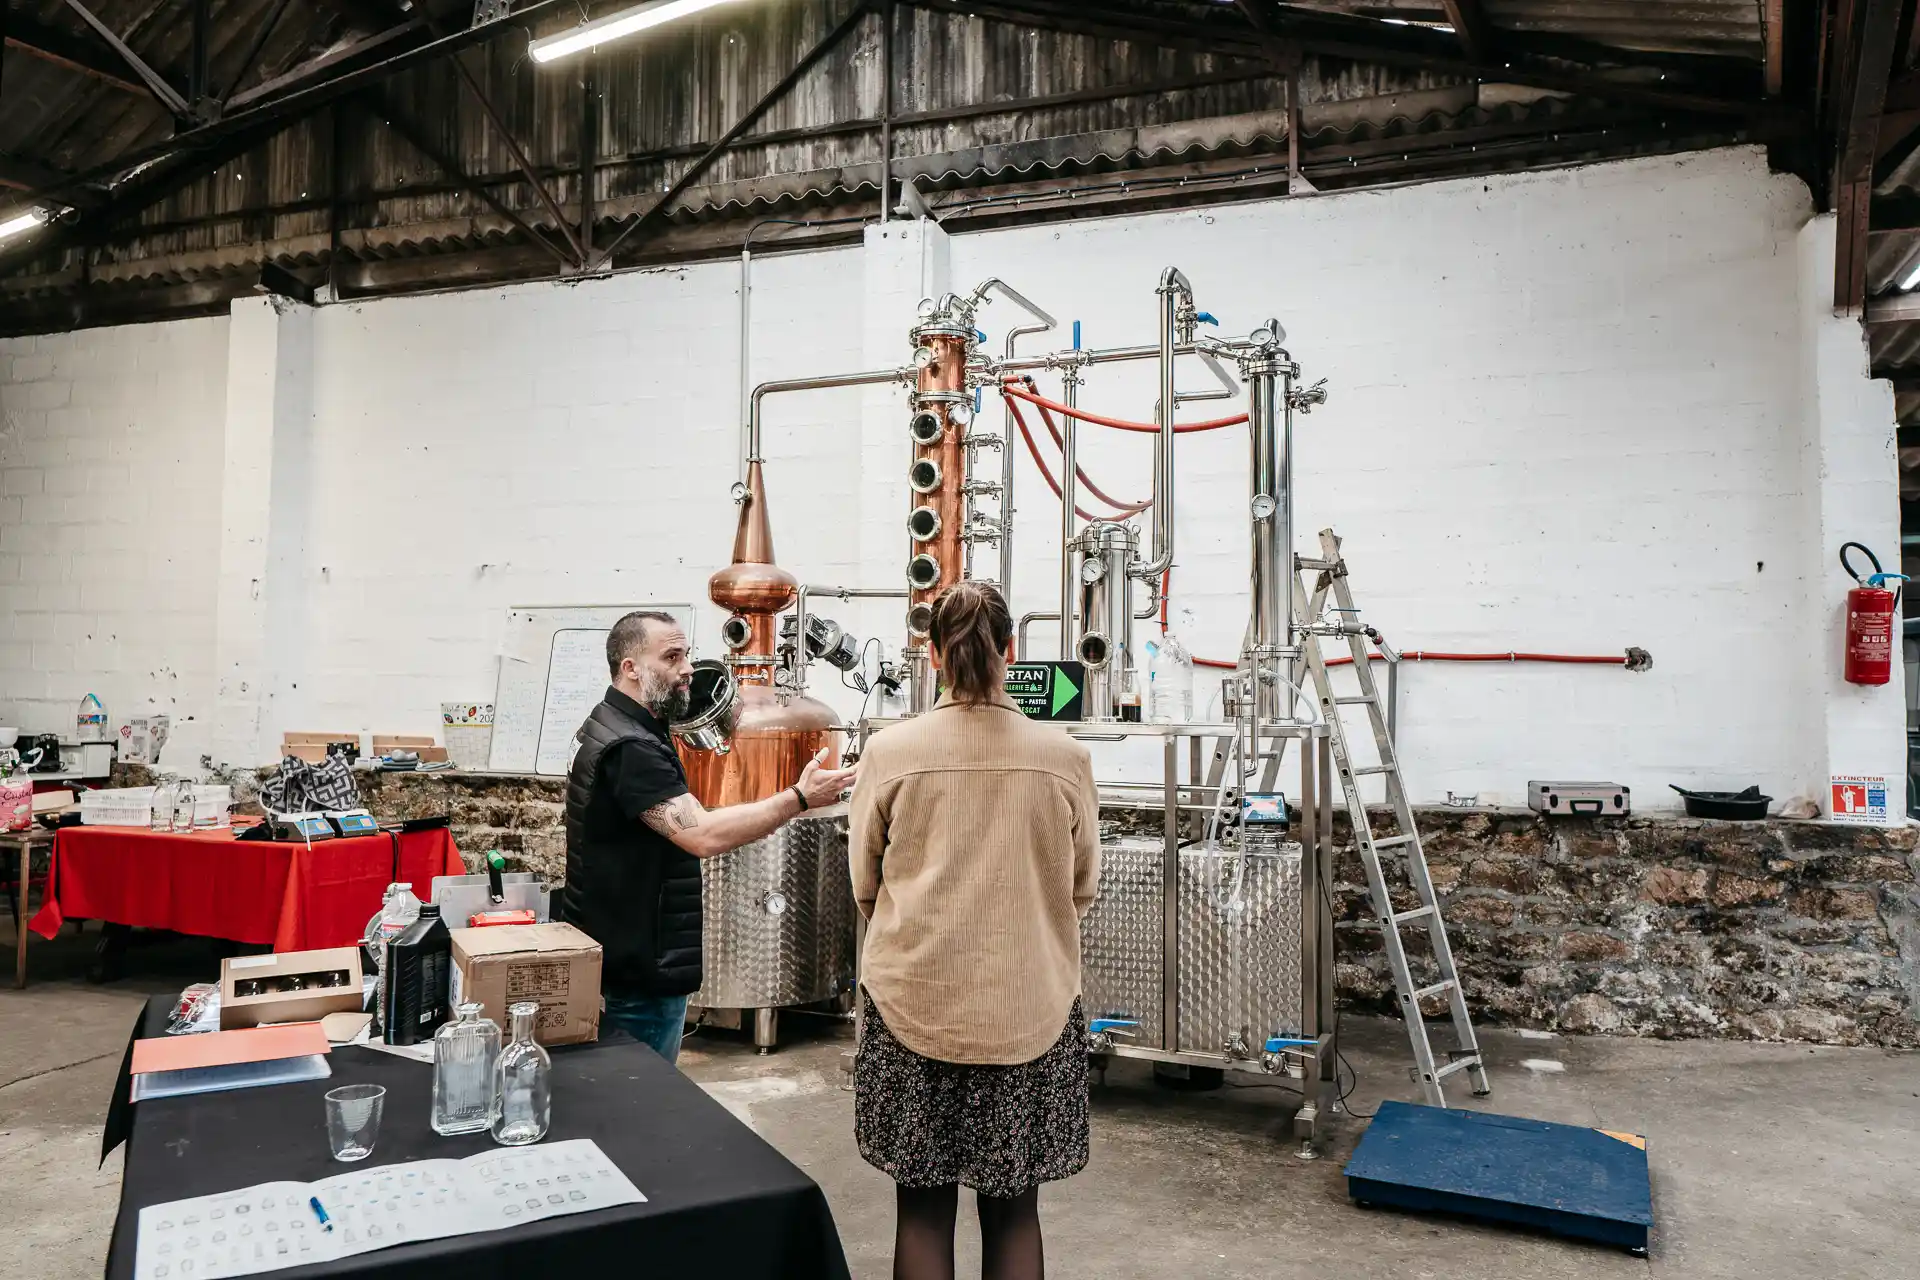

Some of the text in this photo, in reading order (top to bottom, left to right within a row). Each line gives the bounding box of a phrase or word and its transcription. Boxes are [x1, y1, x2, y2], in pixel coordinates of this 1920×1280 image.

[1006, 670, 1043, 680] RTAN
[1020, 706, 1040, 714] ESCAT
[479, 714, 494, 723] 202
